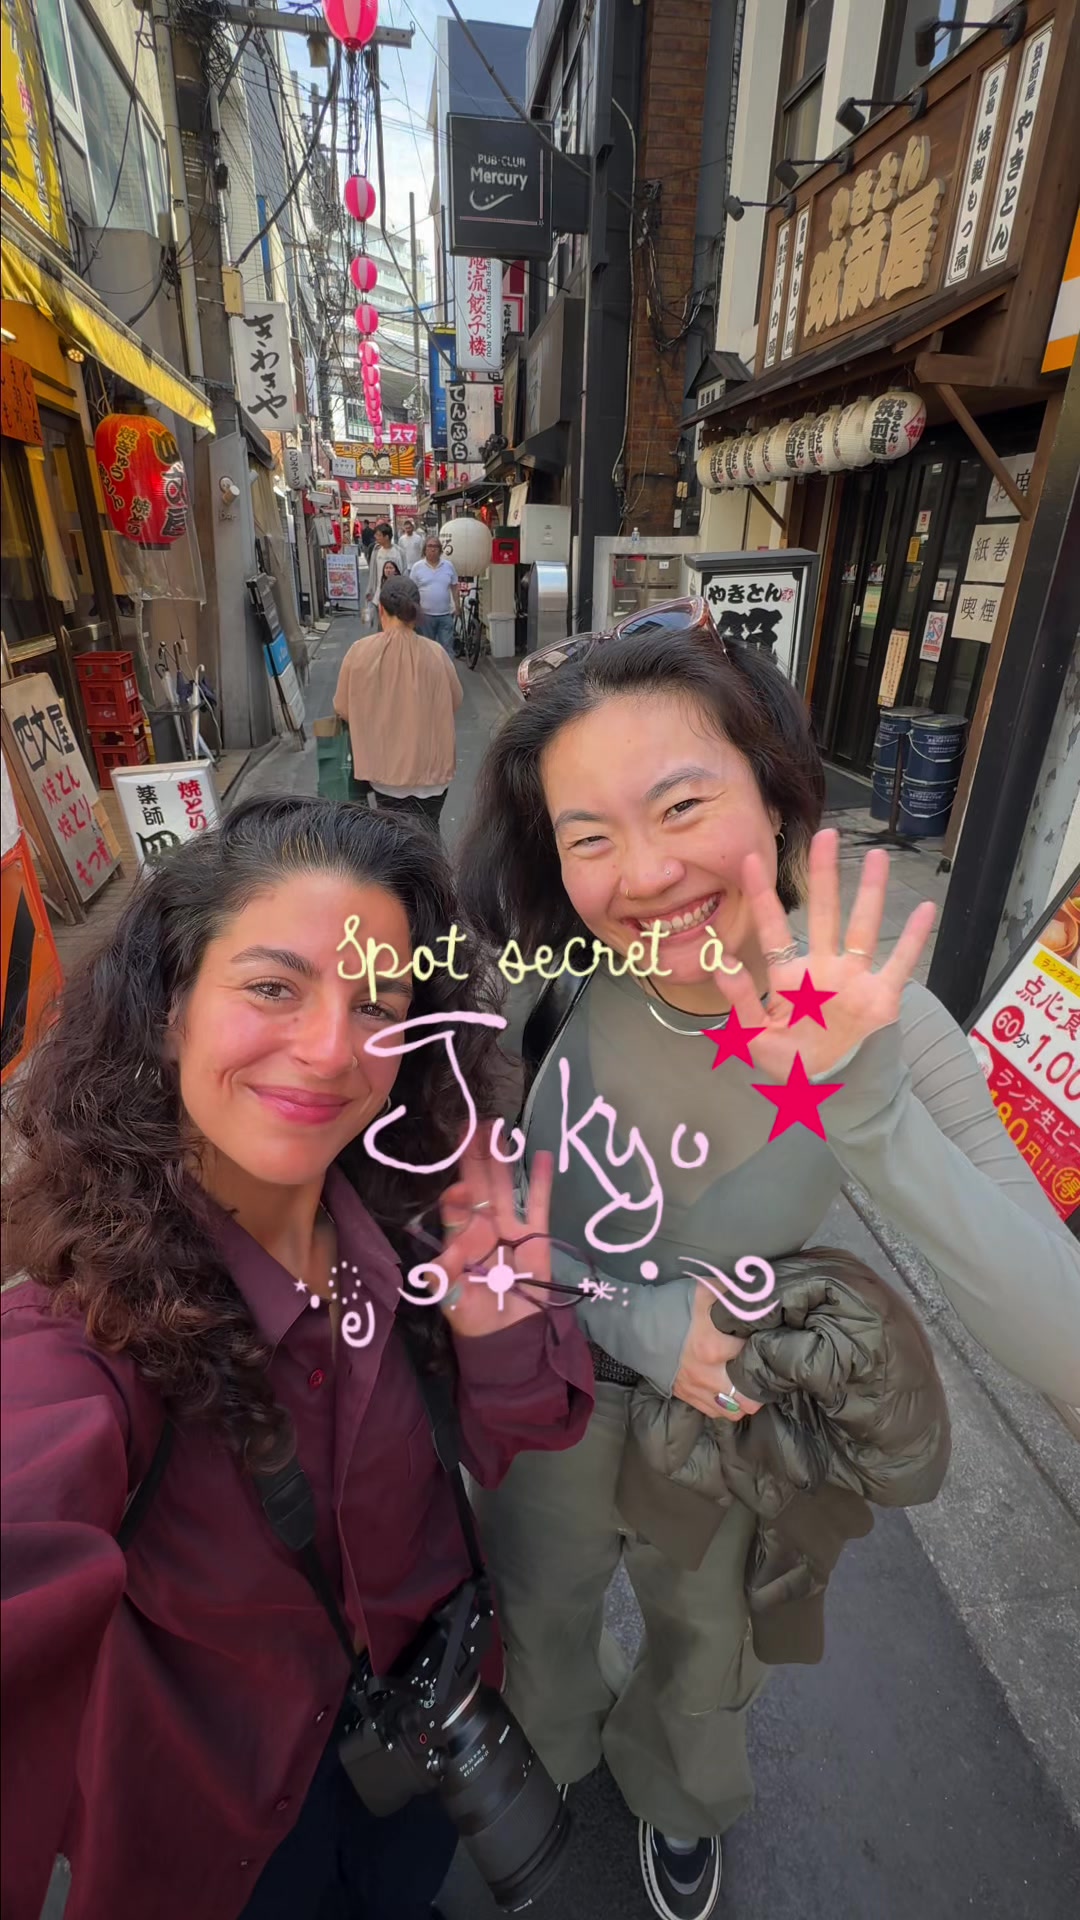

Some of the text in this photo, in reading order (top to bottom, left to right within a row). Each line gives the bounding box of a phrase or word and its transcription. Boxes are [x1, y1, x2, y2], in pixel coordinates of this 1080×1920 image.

[470, 166, 528, 191] Mercury
[829, 135, 931, 240] やきとん
[954, 125, 992, 273] 特製もつ煮
[992, 110, 1033, 254] やきとん
[450, 383, 468, 461] てんぷら
[888, 400, 908, 443] やきとん
[973, 536, 1010, 563] 紙巻
[707, 582, 782, 605] やきとん
[960, 596, 998, 623] 喫煙
[136, 784, 165, 826] 薬師
[177, 779, 207, 830] 焼とり
